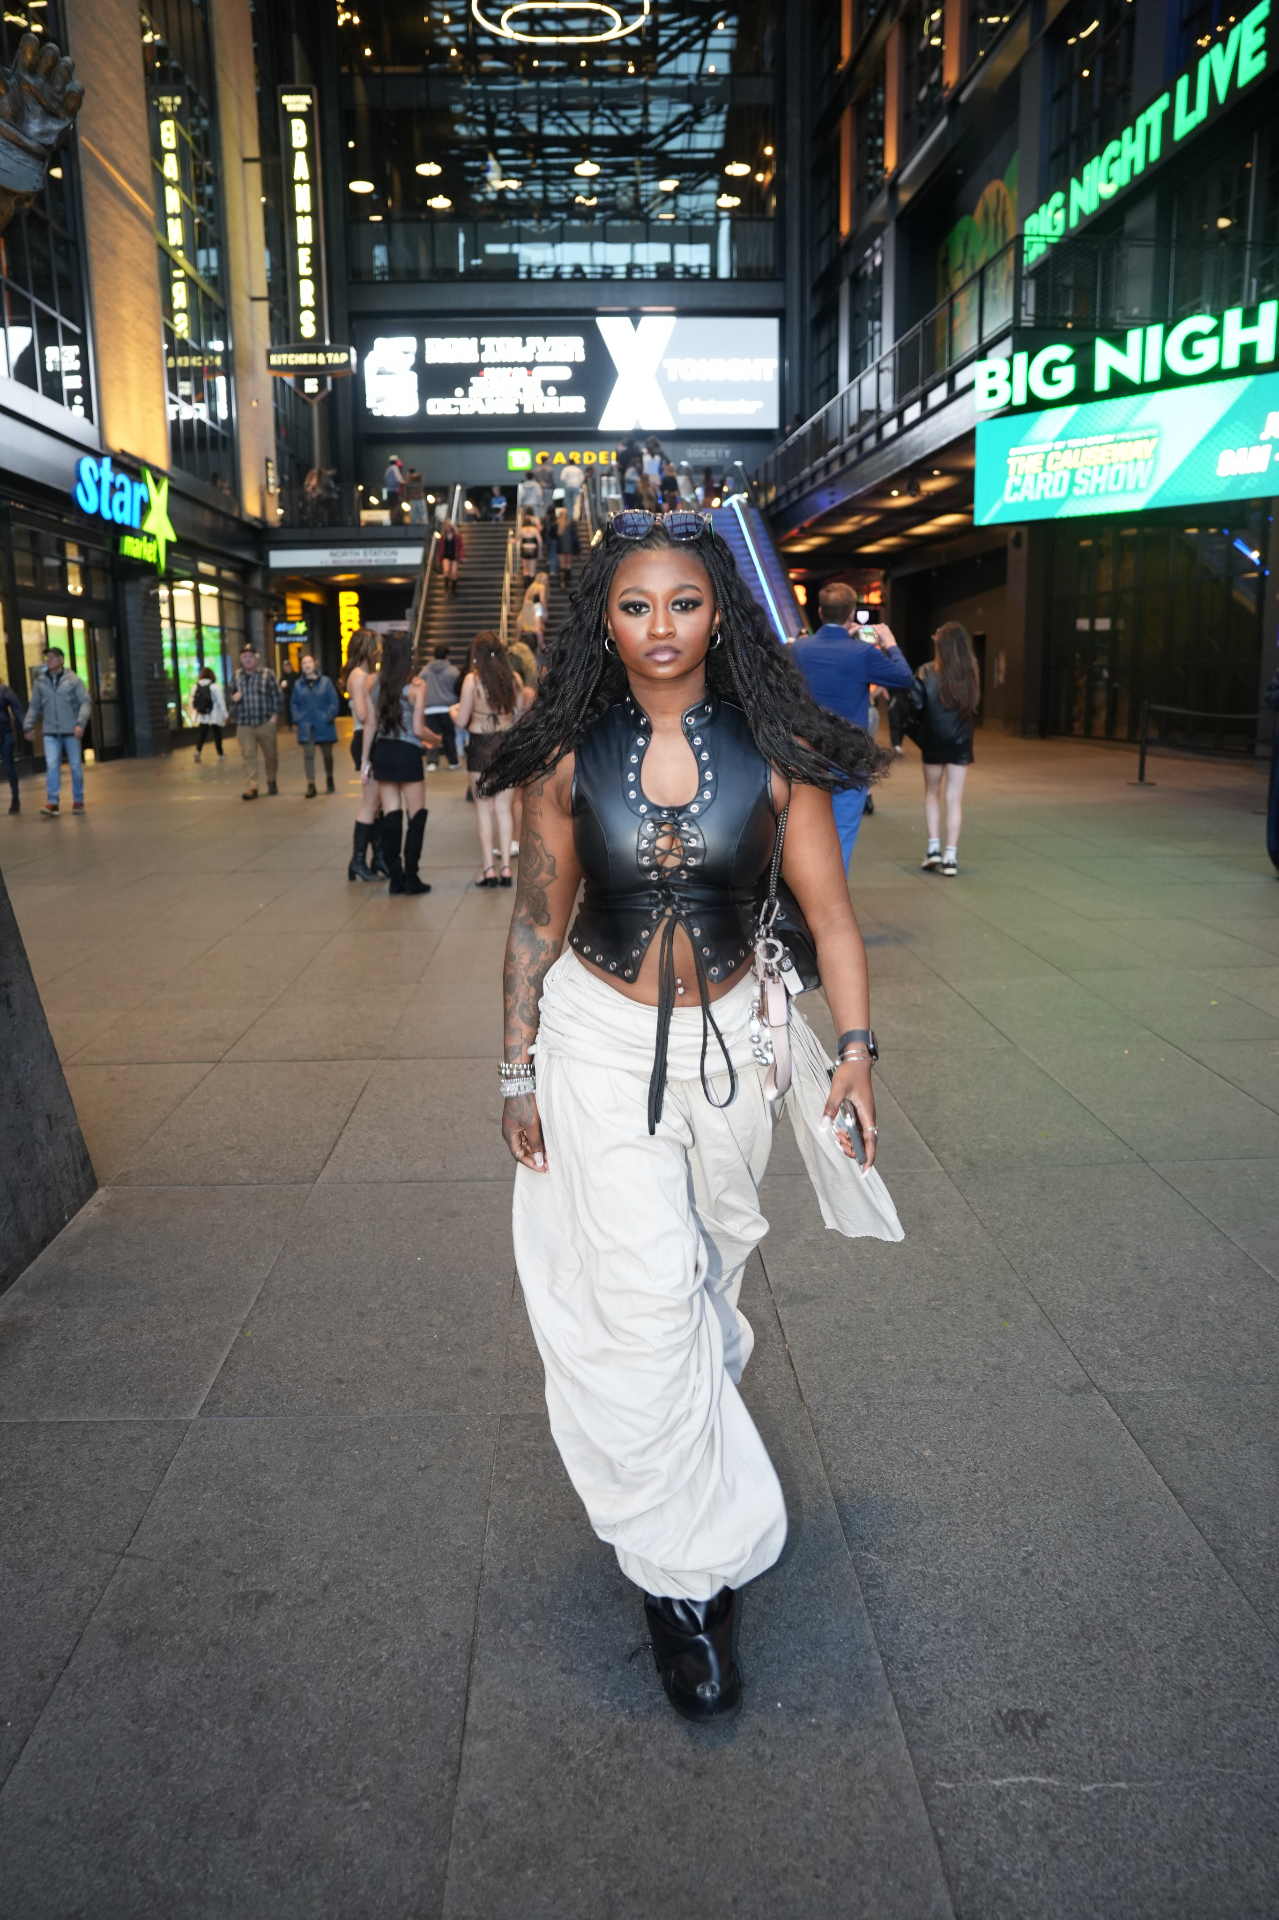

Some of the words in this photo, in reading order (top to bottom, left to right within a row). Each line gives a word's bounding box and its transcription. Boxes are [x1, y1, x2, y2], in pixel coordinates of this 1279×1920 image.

[1024, 191, 1065, 266] BIG
[1069, 92, 1170, 229] NIGHT
[1174, 0, 1270, 141] LIVE
[291, 118, 316, 339] BANNERS
[269, 353, 316, 365] KITCHEN
[326, 352, 348, 364] TAP
[974, 343, 1076, 413] BIG
[508, 451, 531, 468] TD
[1003, 469, 1071, 504] CARD
[1072, 459, 1154, 496] SHOW
[1006, 453, 1046, 477] THE
[1045, 438, 1159, 472] CAUSEWAY
[74, 456, 150, 529] Star
